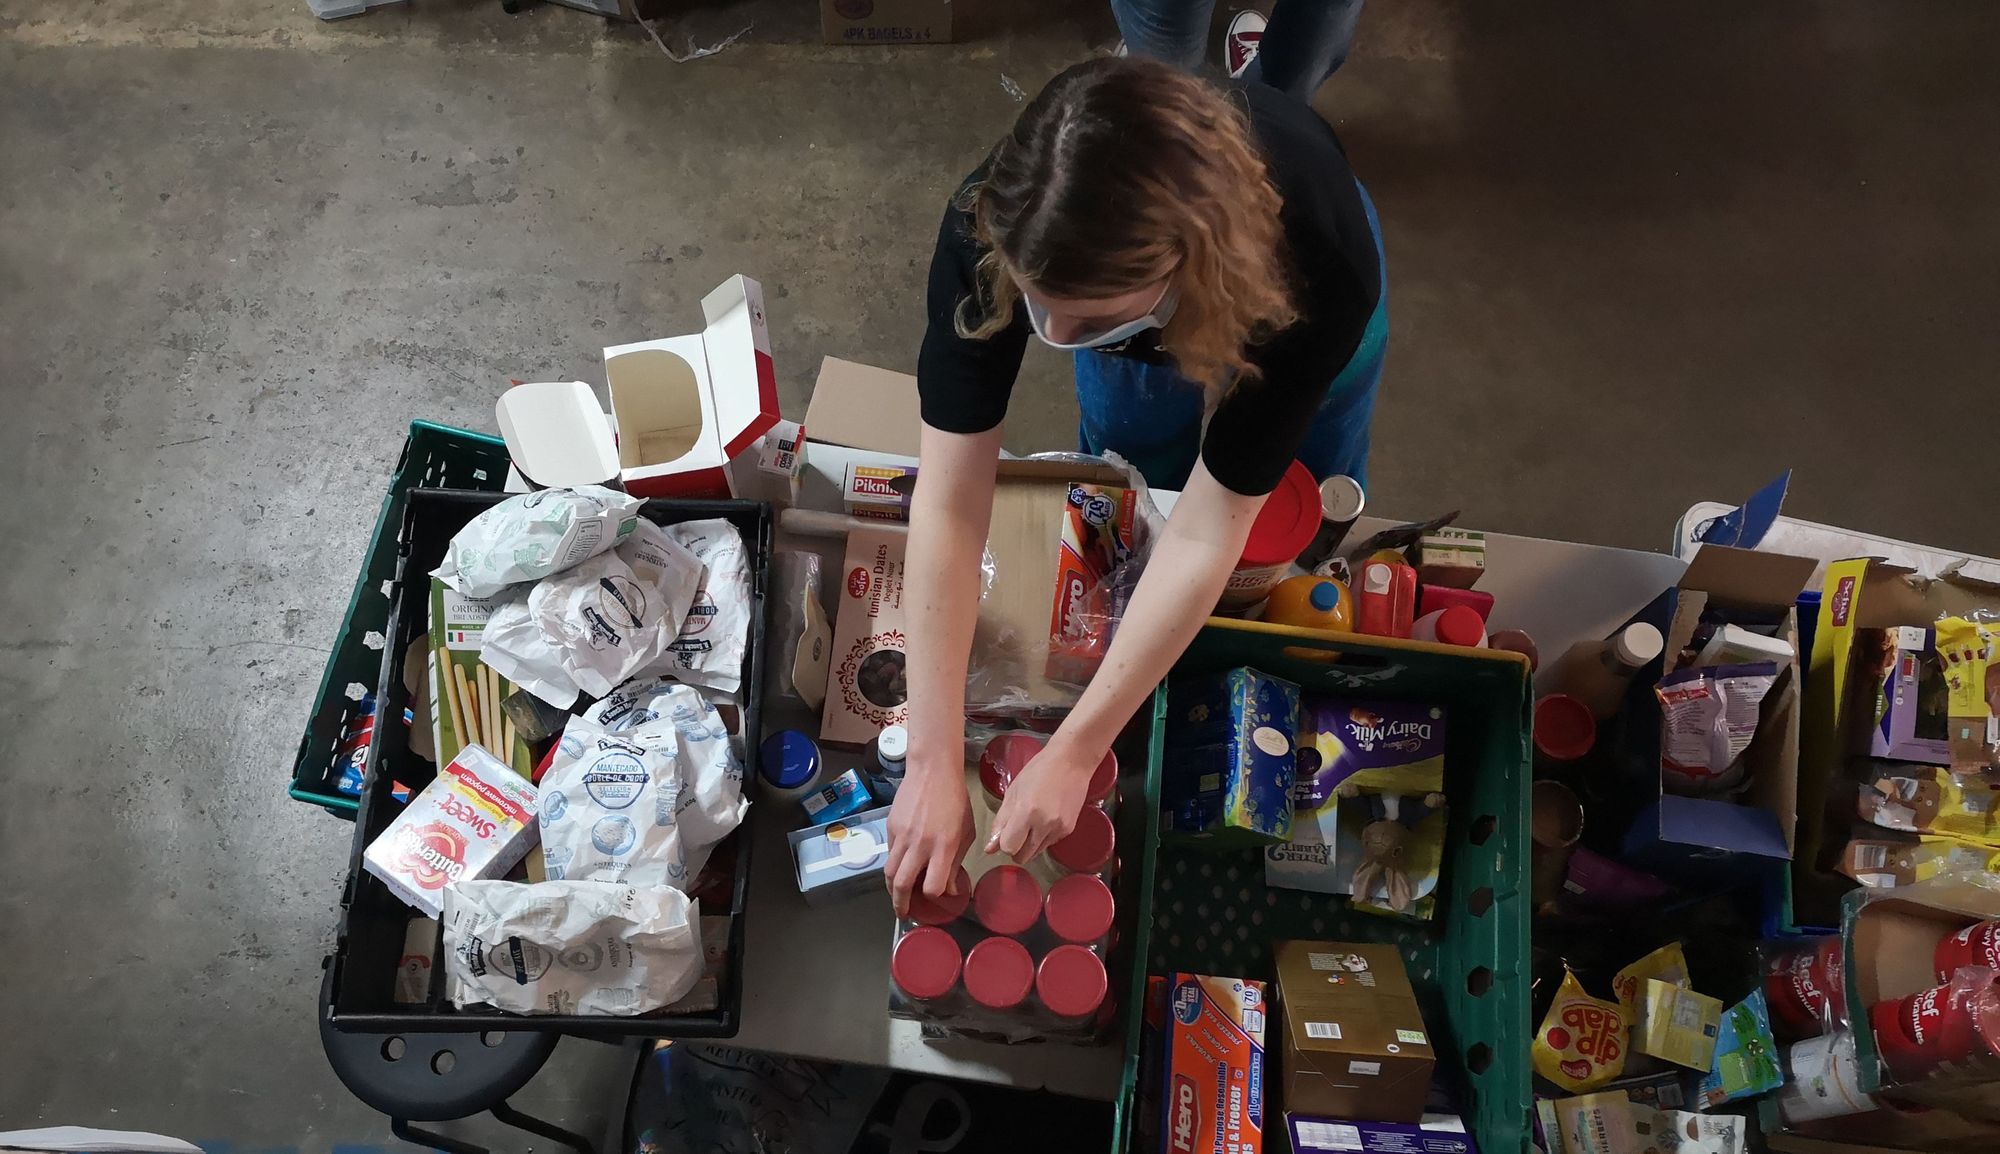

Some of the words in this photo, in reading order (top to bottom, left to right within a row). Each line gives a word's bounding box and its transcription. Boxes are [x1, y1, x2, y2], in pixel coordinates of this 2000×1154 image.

[867, 27, 912, 40] BAGELS
[873, 544, 888, 574] Dates
[856, 570, 867, 597] Sofra
[883, 582, 893, 603] Deglet
[867, 576, 883, 618] Tunisian
[1345, 723, 1385, 741] Milk
[1387, 720, 1432, 740] Dairy
[596, 763, 639, 773] MANTECADO
[460, 772, 487, 793] popcorn
[485, 789, 518, 814] microwave
[1282, 843, 1333, 855] RABBIT
[1287, 852, 1328, 865] PETER
[1800, 955, 1822, 1000] Beef
[1244, 990, 1254, 1002] 70
[1792, 974, 1820, 1021] Granules
[1562, 1008, 1620, 1036] dab
[1576, 1030, 1621, 1066] dip
[1216, 1061, 1227, 1110] Resealable
[1174, 1083, 1193, 1152] Hero
[1227, 1085, 1241, 1130] Freezer
[1229, 1132, 1240, 1142] &
